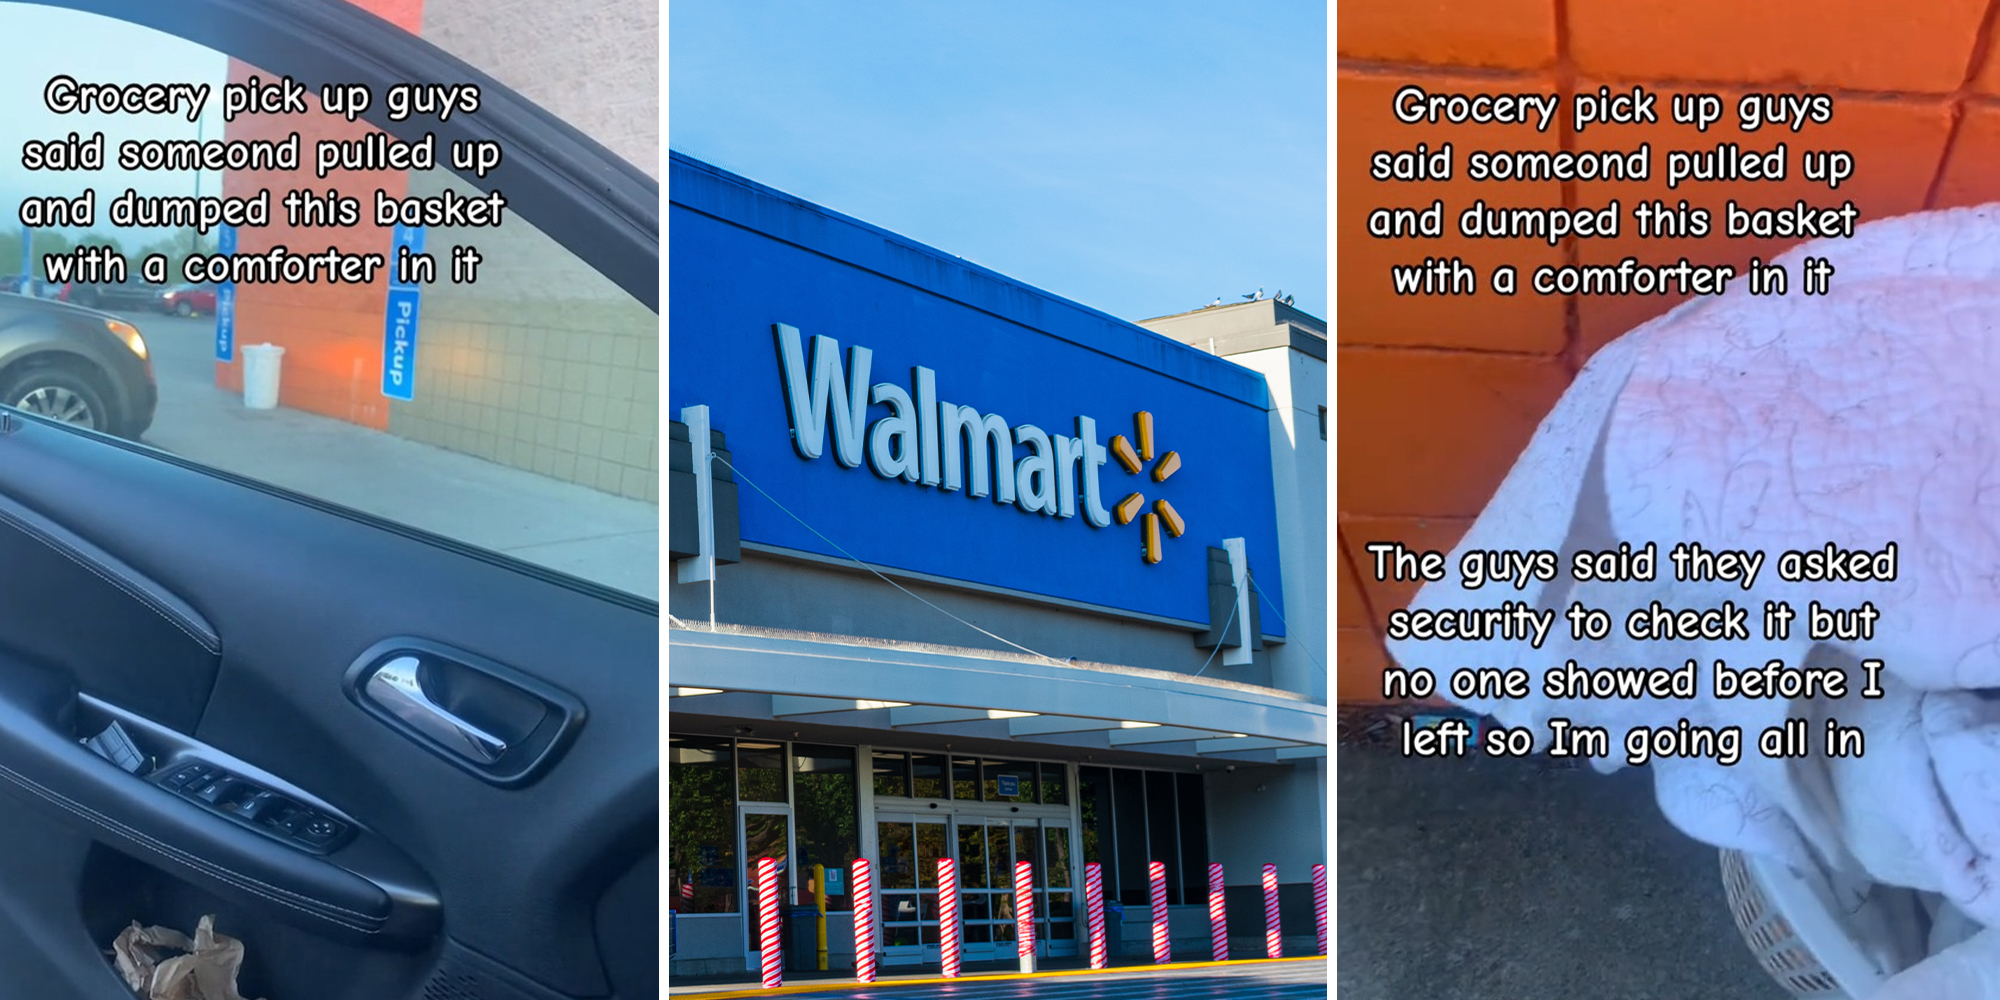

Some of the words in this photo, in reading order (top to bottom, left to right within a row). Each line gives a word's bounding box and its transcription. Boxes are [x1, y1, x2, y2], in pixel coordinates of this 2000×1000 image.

[218, 288, 232, 353] Pickup
[389, 301, 412, 387] Pickup
[771, 322, 1110, 528] Walmart
